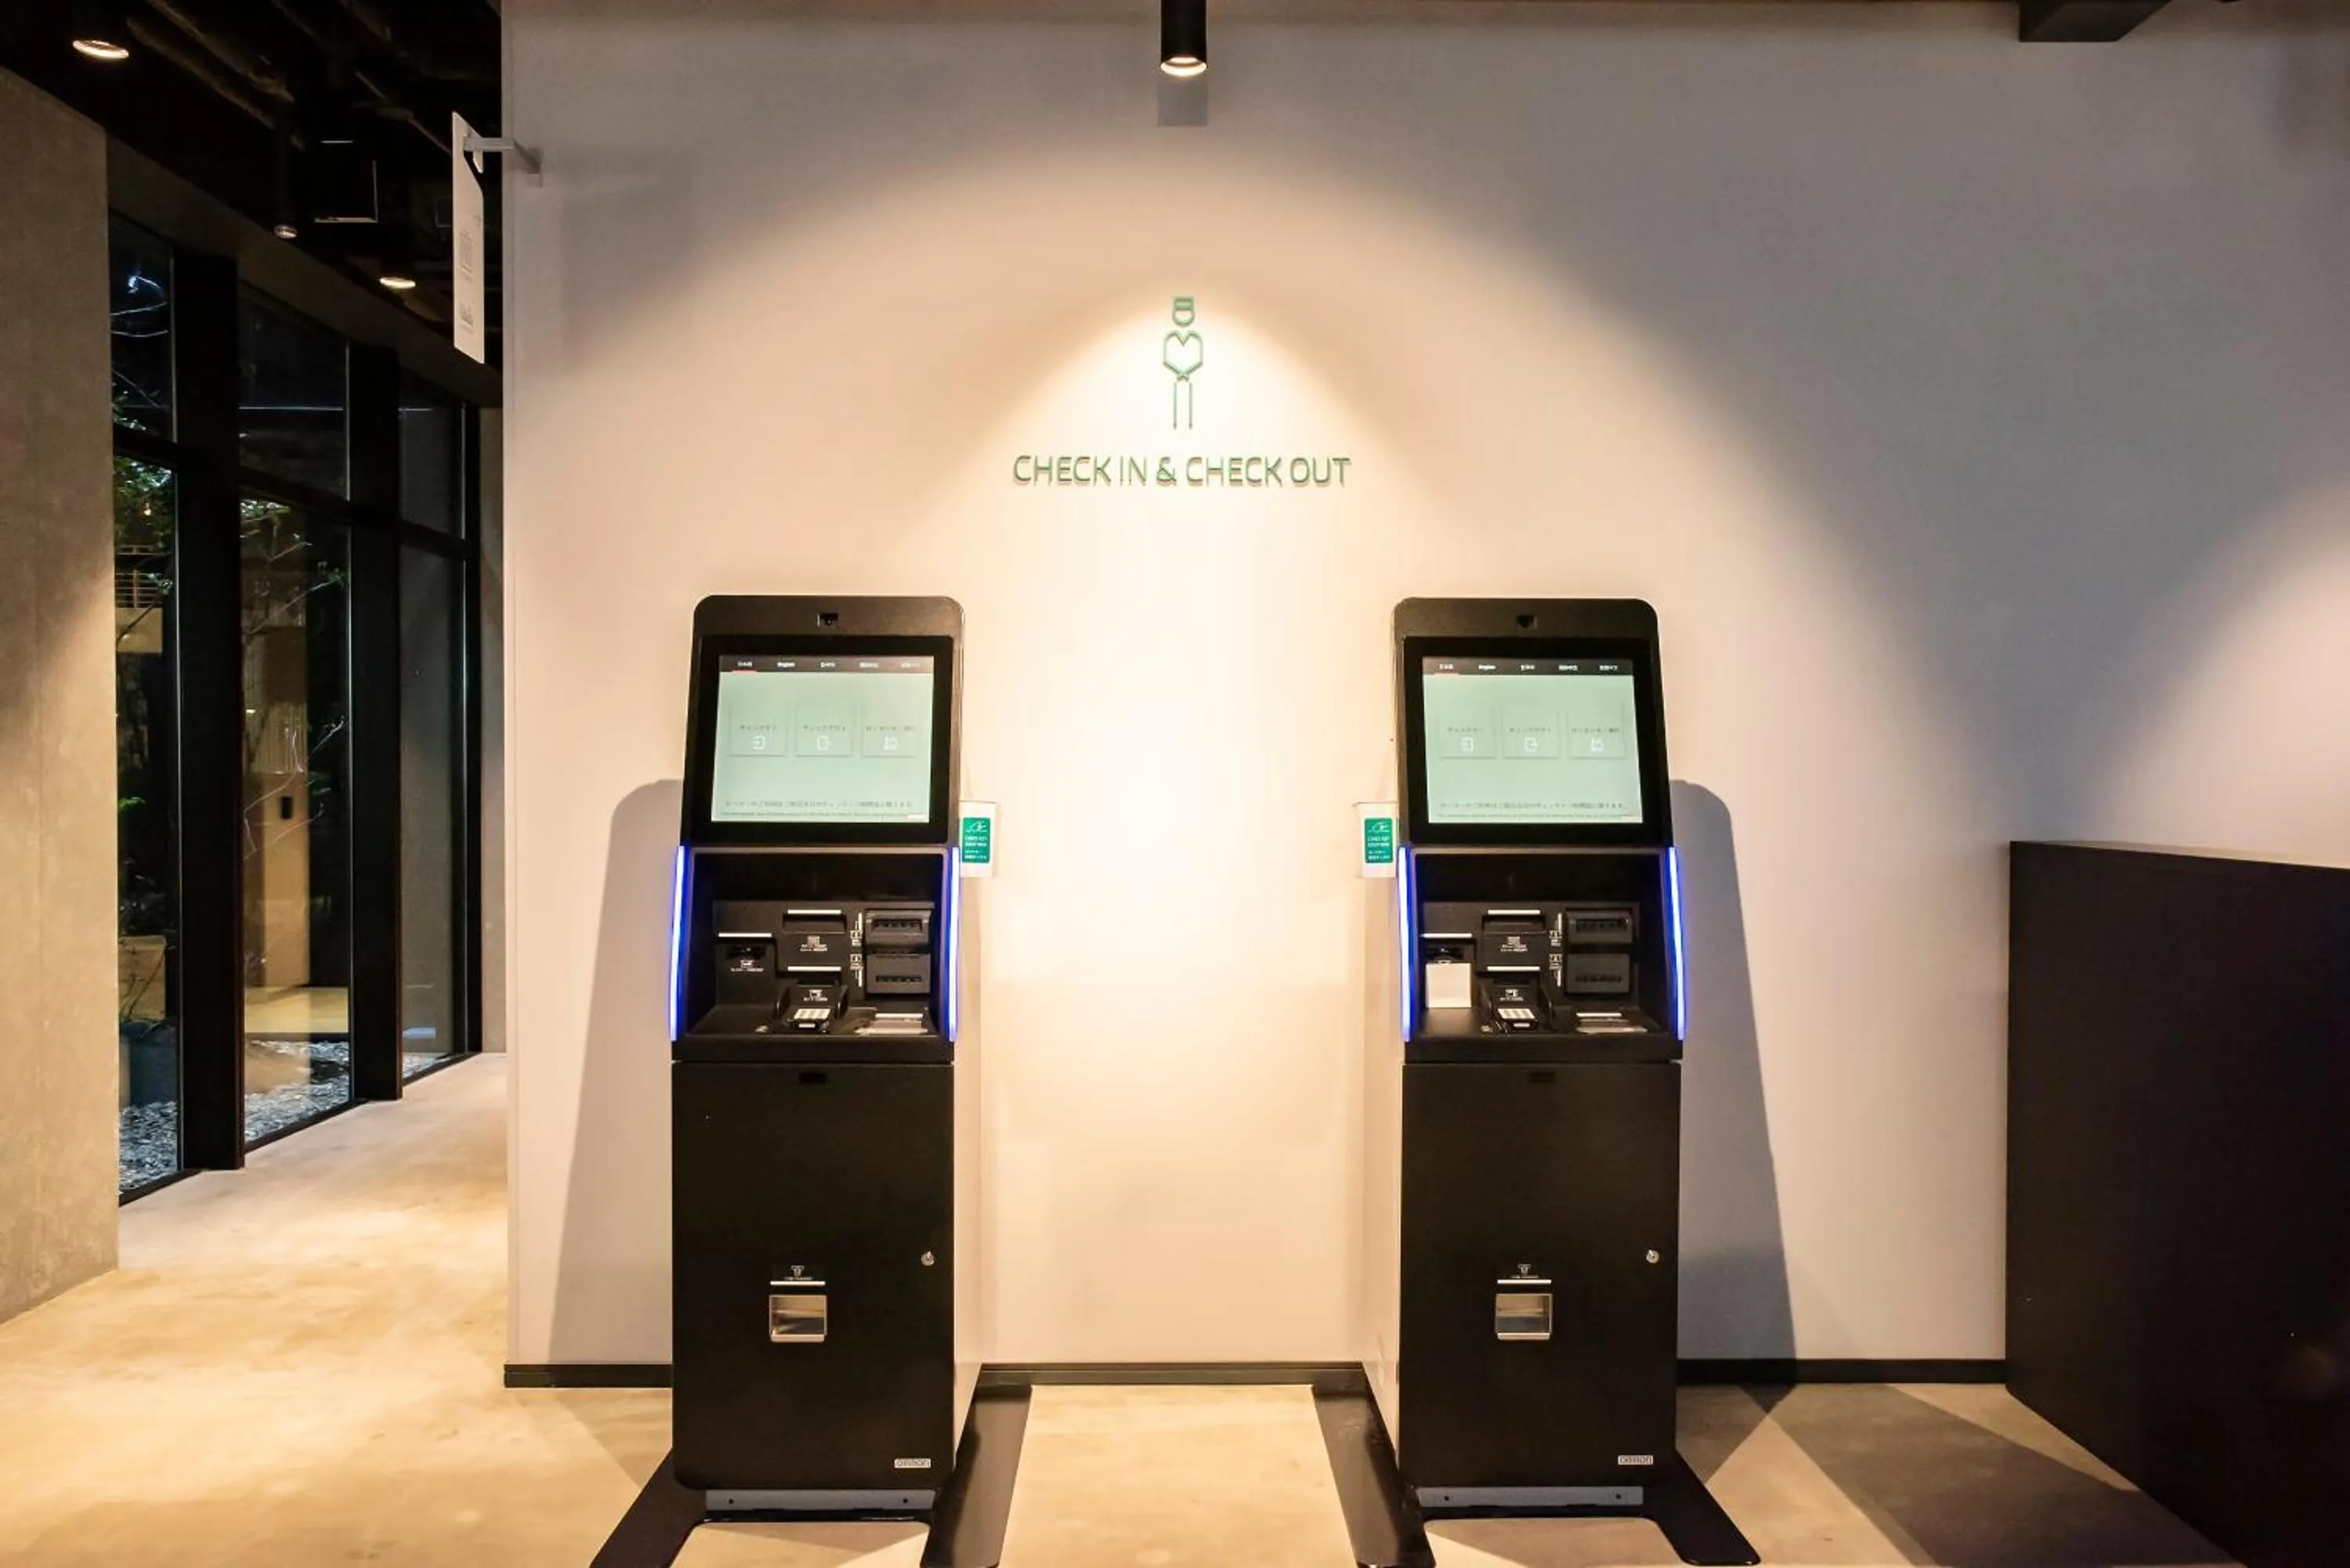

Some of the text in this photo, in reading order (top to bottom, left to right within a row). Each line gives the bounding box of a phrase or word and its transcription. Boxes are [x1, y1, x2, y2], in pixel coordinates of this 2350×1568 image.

[1014, 455, 1351, 486] CHECK IN & CHECK OUT
